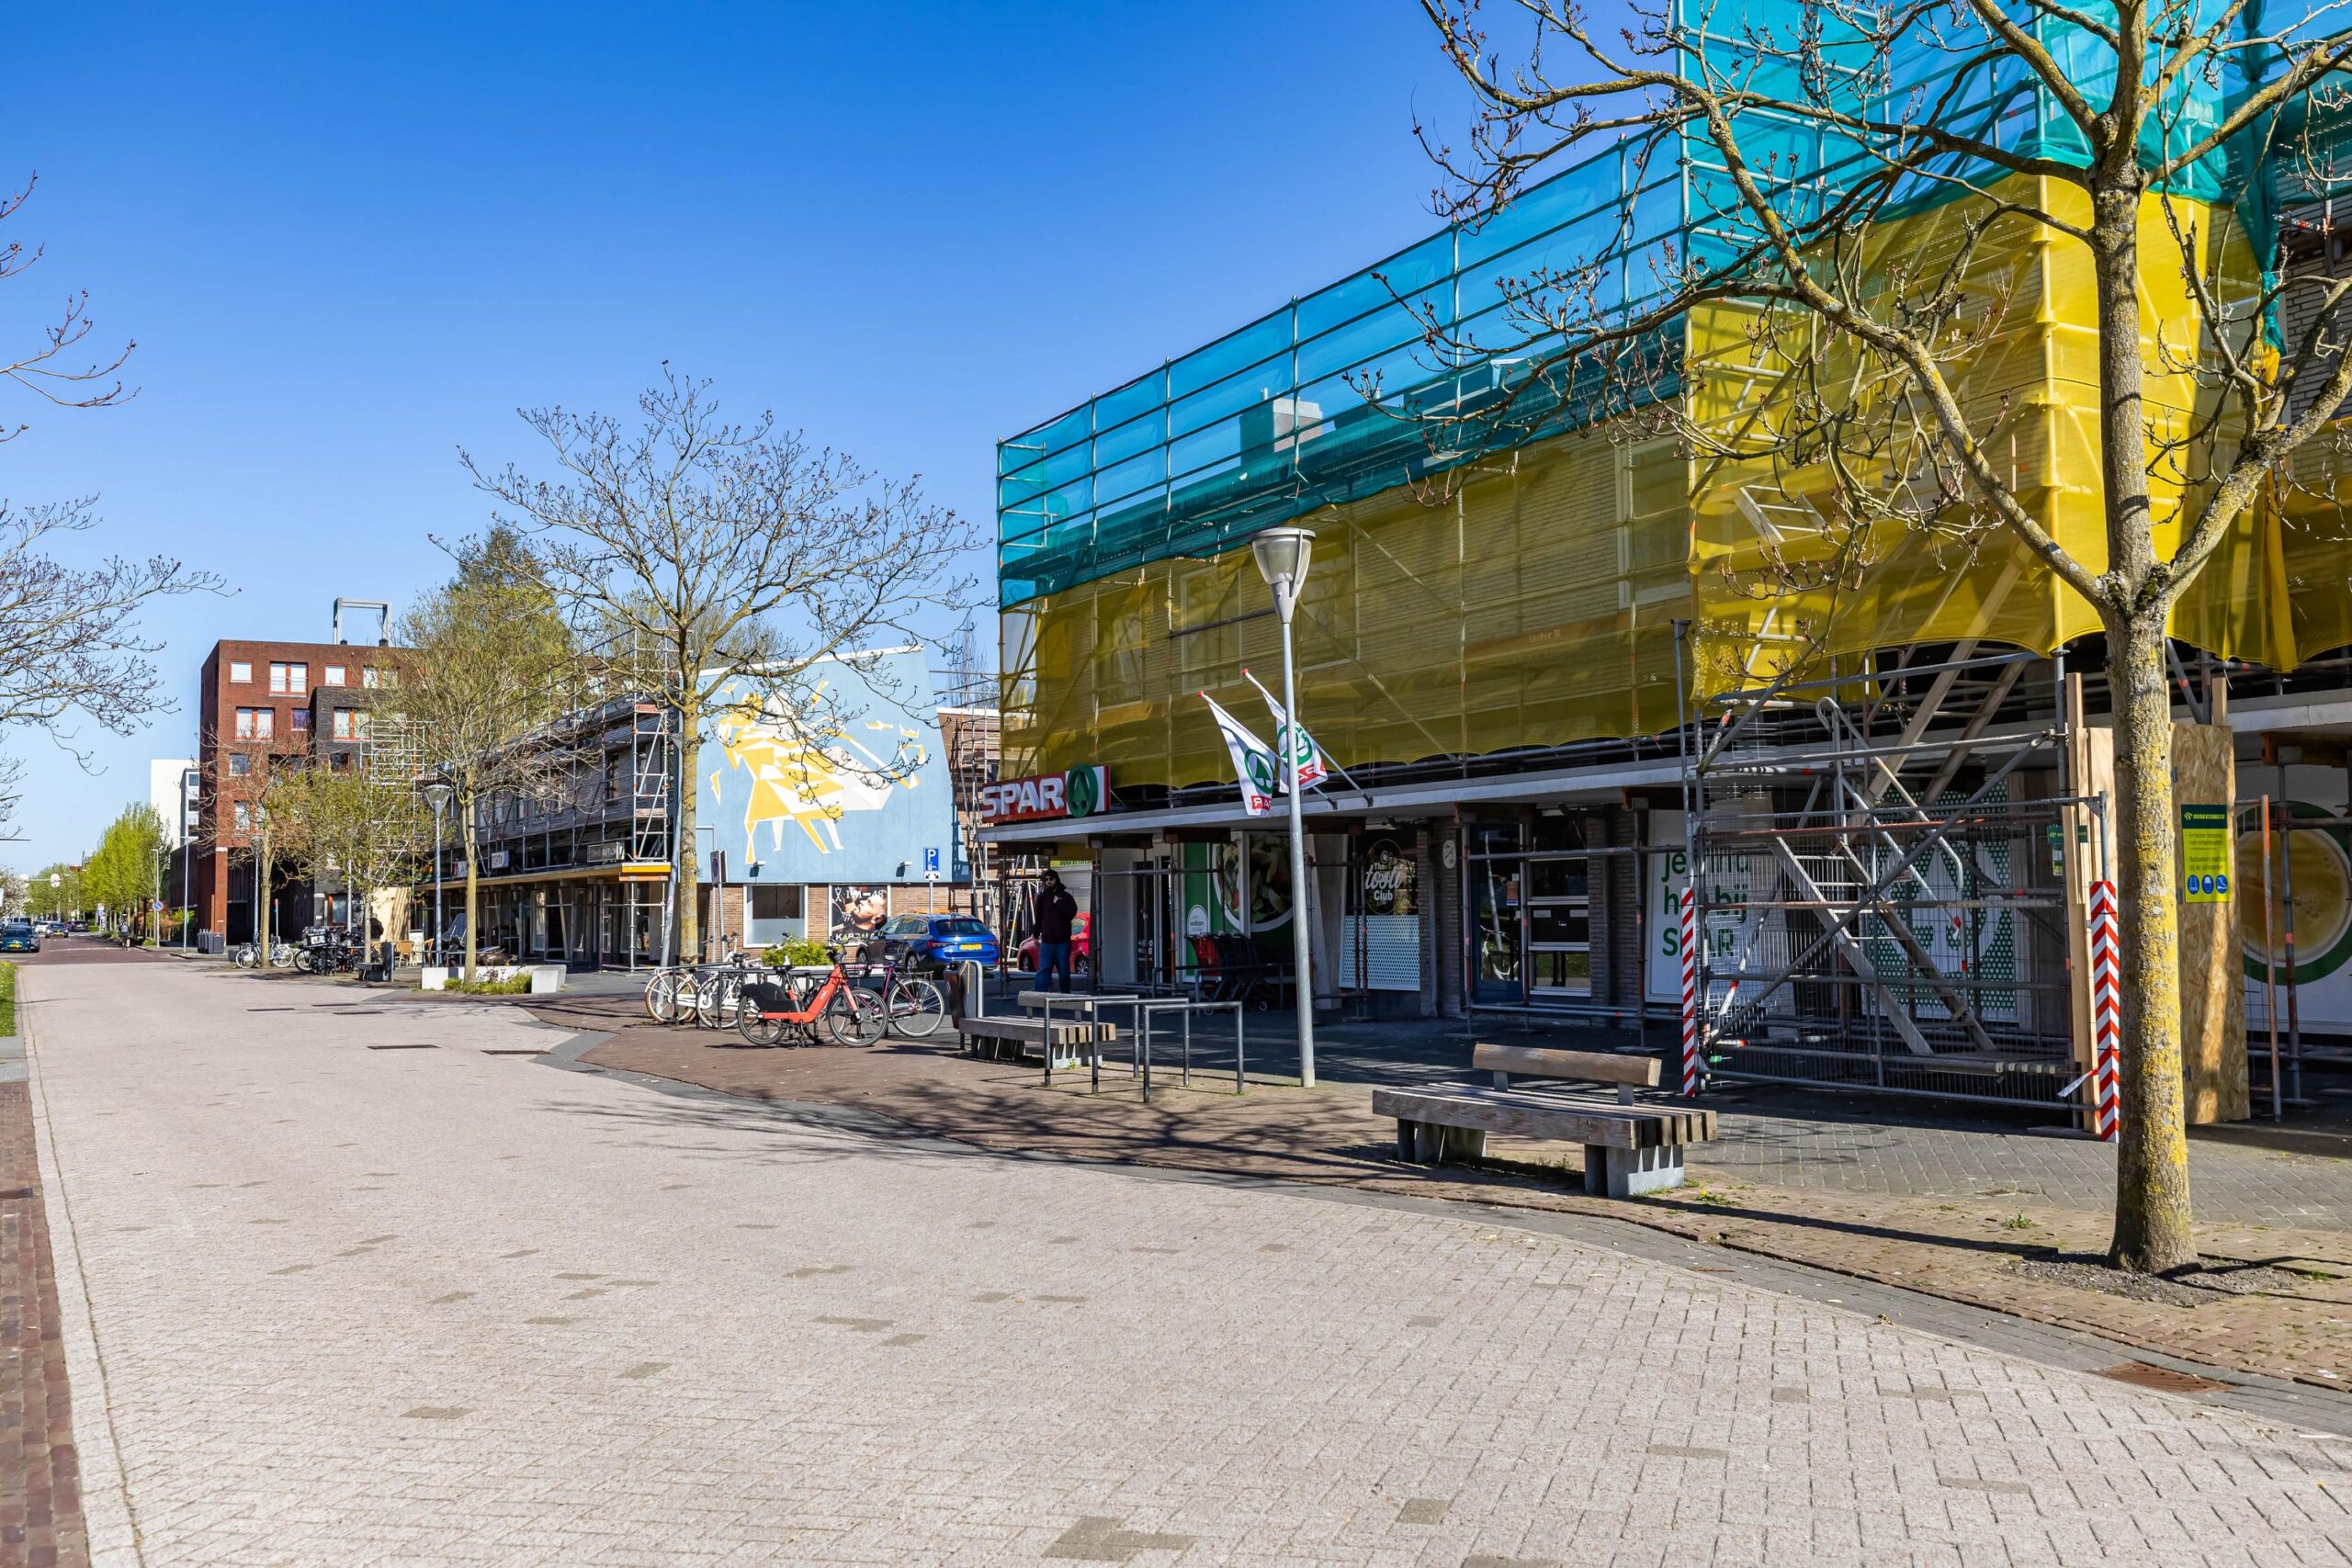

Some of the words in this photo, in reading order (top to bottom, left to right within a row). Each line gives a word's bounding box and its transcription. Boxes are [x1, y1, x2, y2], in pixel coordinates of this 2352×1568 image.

[982, 777, 1064, 818] SPAR
[928, 849, 936, 861] P
[1661, 844, 1687, 883] je
[1374, 890, 1394, 901] Club
[1662, 927, 1735, 957] SAR
